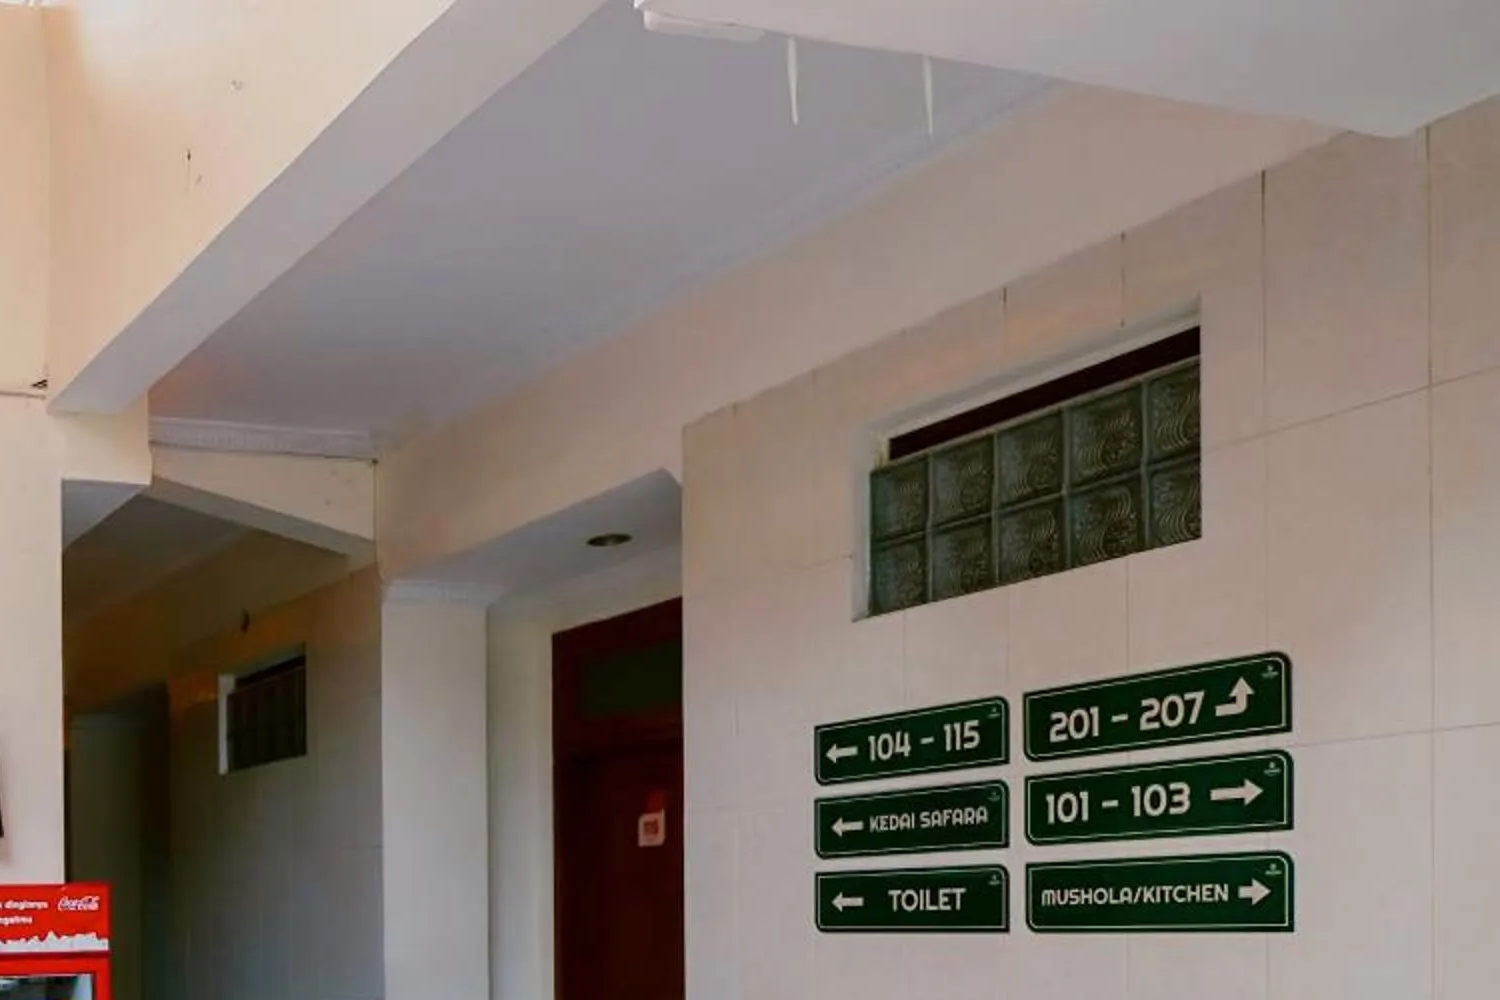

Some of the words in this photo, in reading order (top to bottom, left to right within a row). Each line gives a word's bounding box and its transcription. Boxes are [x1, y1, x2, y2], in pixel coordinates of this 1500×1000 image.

[1048, 706, 1100, 743] 201
[1139, 690, 1206, 732] 207
[868, 730, 911, 761] 104
[943, 719, 980, 751] 115
[869, 812, 915, 832] KEDAI
[919, 806, 989, 829] SAFARA
[1046, 791, 1090, 825] 101
[1131, 781, 1191, 818] 103
[887, 887, 967, 912] TOILET
[1041, 882, 1229, 908] MUSHOLA/KITCHEN
